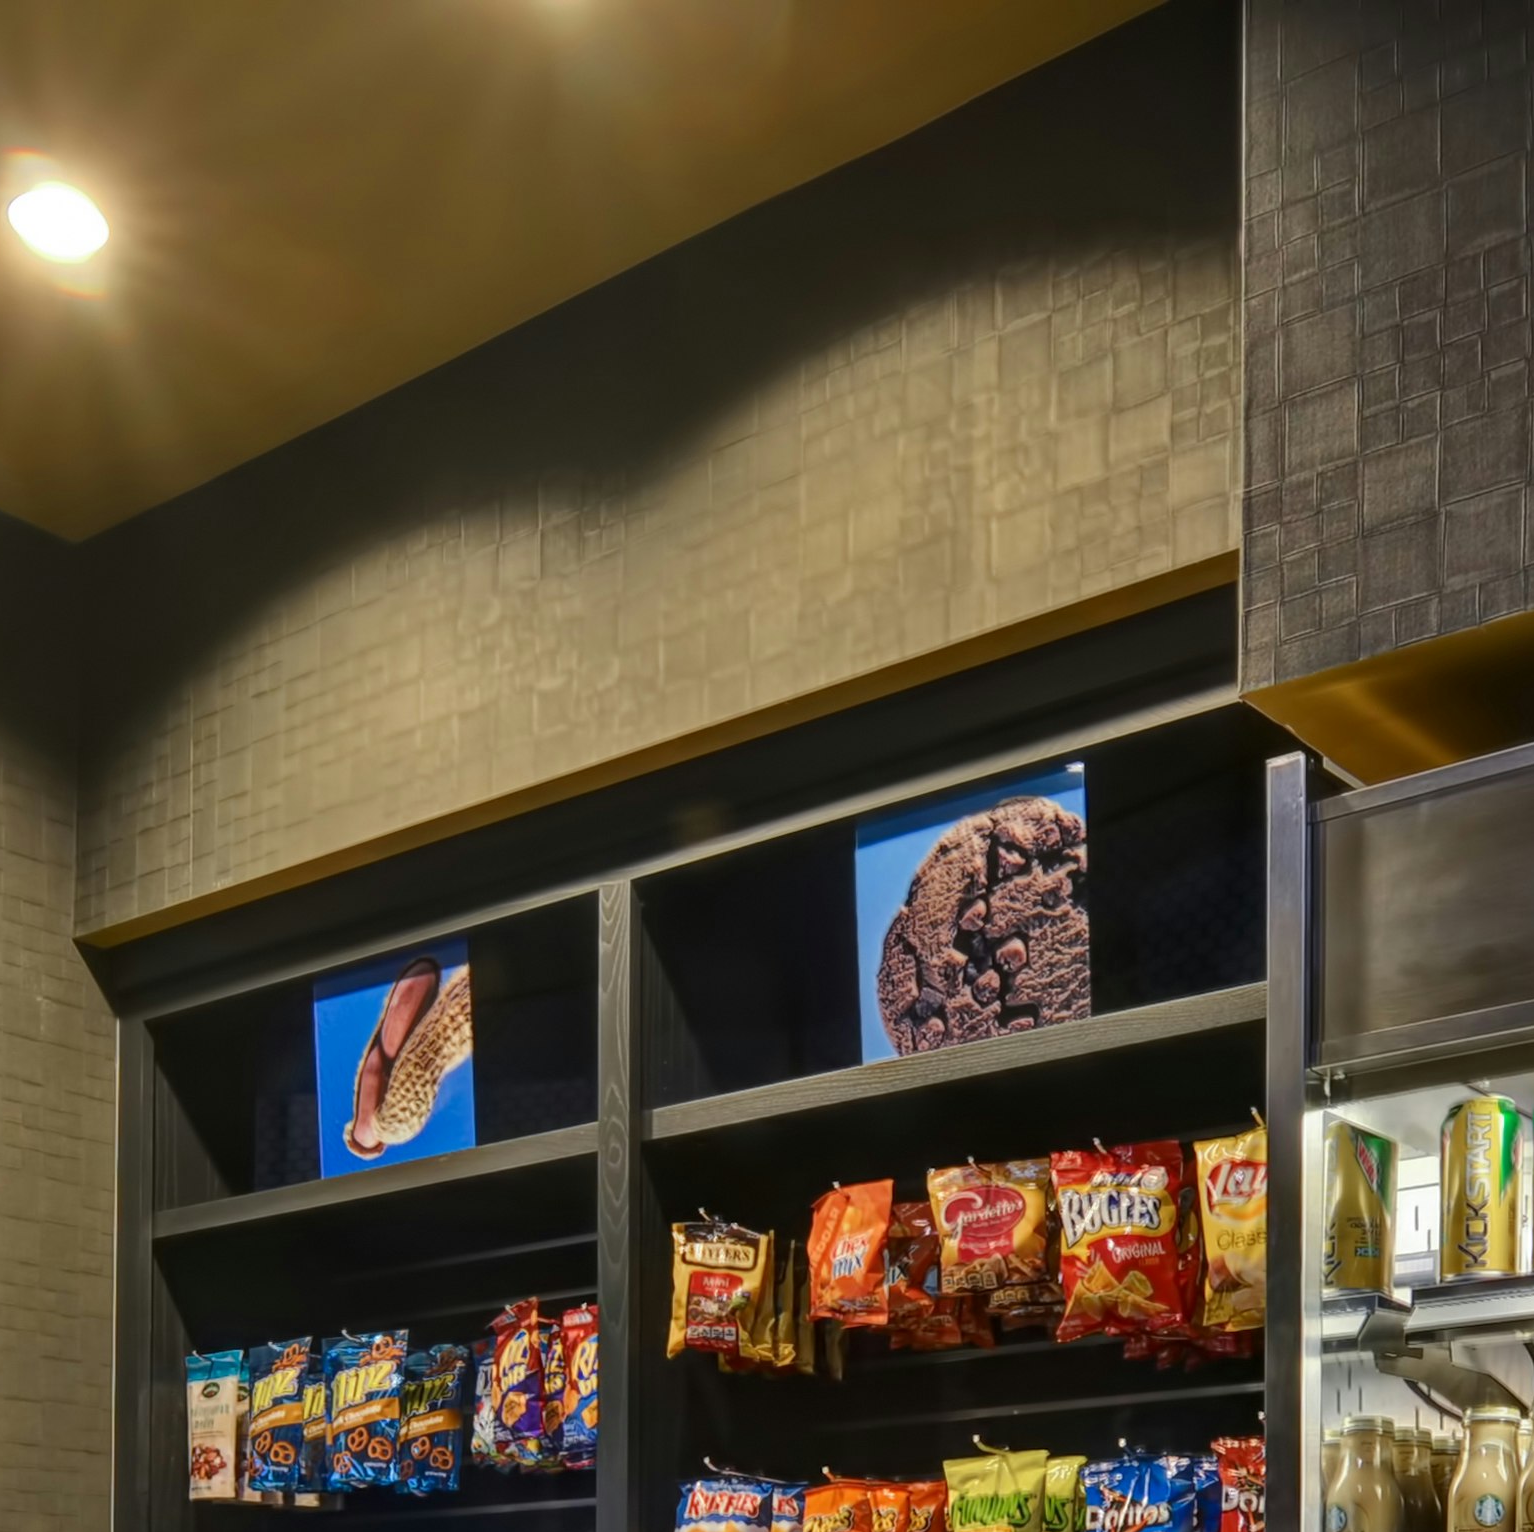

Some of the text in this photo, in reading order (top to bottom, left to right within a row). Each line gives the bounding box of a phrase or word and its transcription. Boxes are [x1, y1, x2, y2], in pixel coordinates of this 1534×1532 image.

[1060, 1187, 1161, 1248] BUGLES
[1112, 1240, 1166, 1264] ORIGINAL
[685, 1492, 761, 1519] RUFFLES
[1086, 1499, 1173, 1532] Doritos
